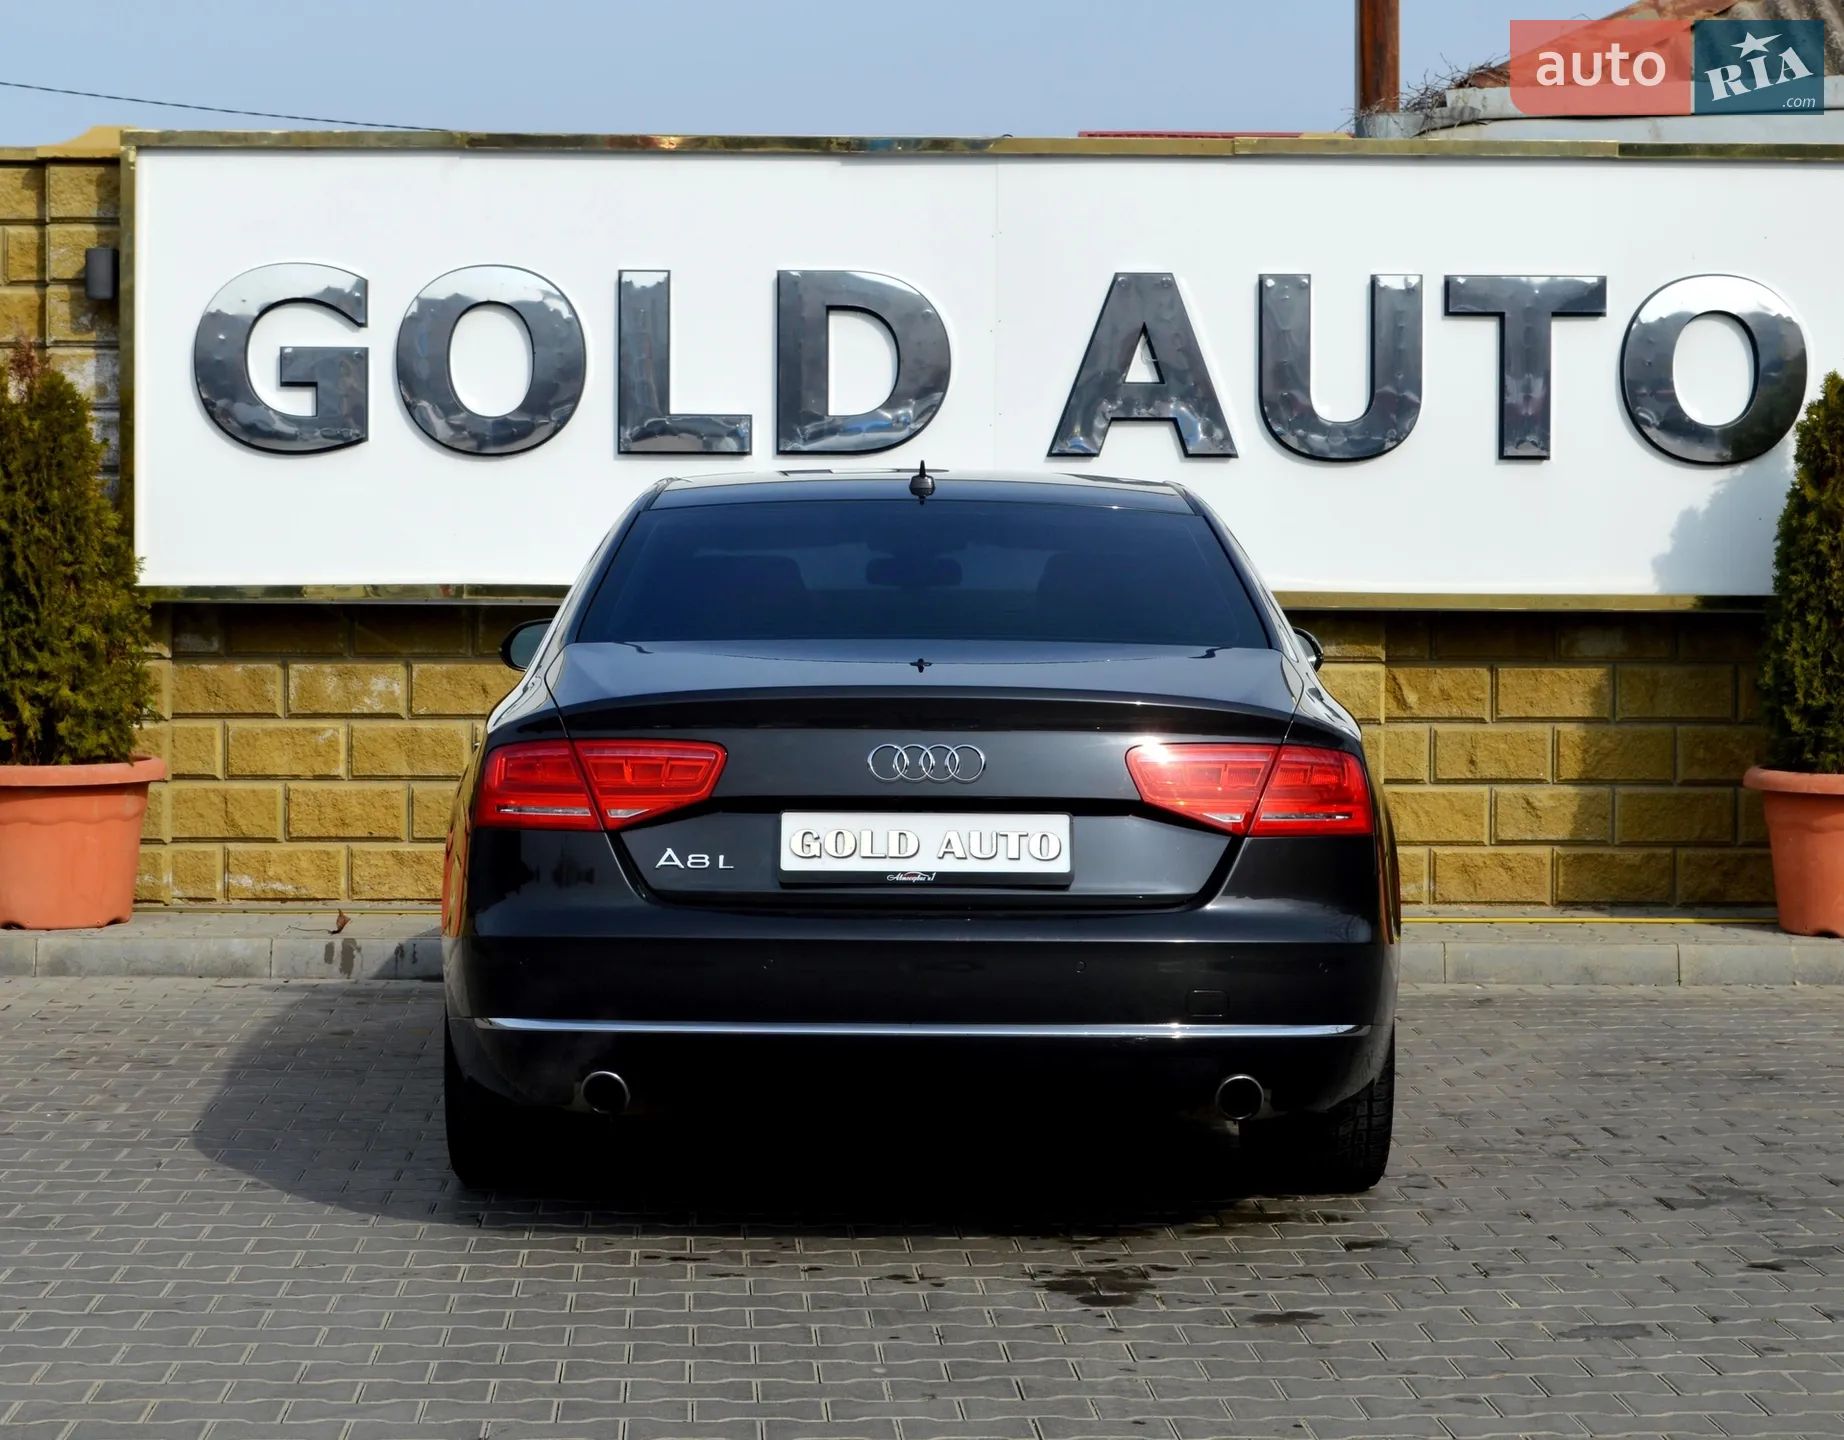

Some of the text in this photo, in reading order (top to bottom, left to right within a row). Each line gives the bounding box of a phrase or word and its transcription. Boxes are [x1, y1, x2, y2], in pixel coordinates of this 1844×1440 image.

[193, 262, 1808, 465] GOLD AUTO
[789, 828, 1062, 861] GOLD AUTO
